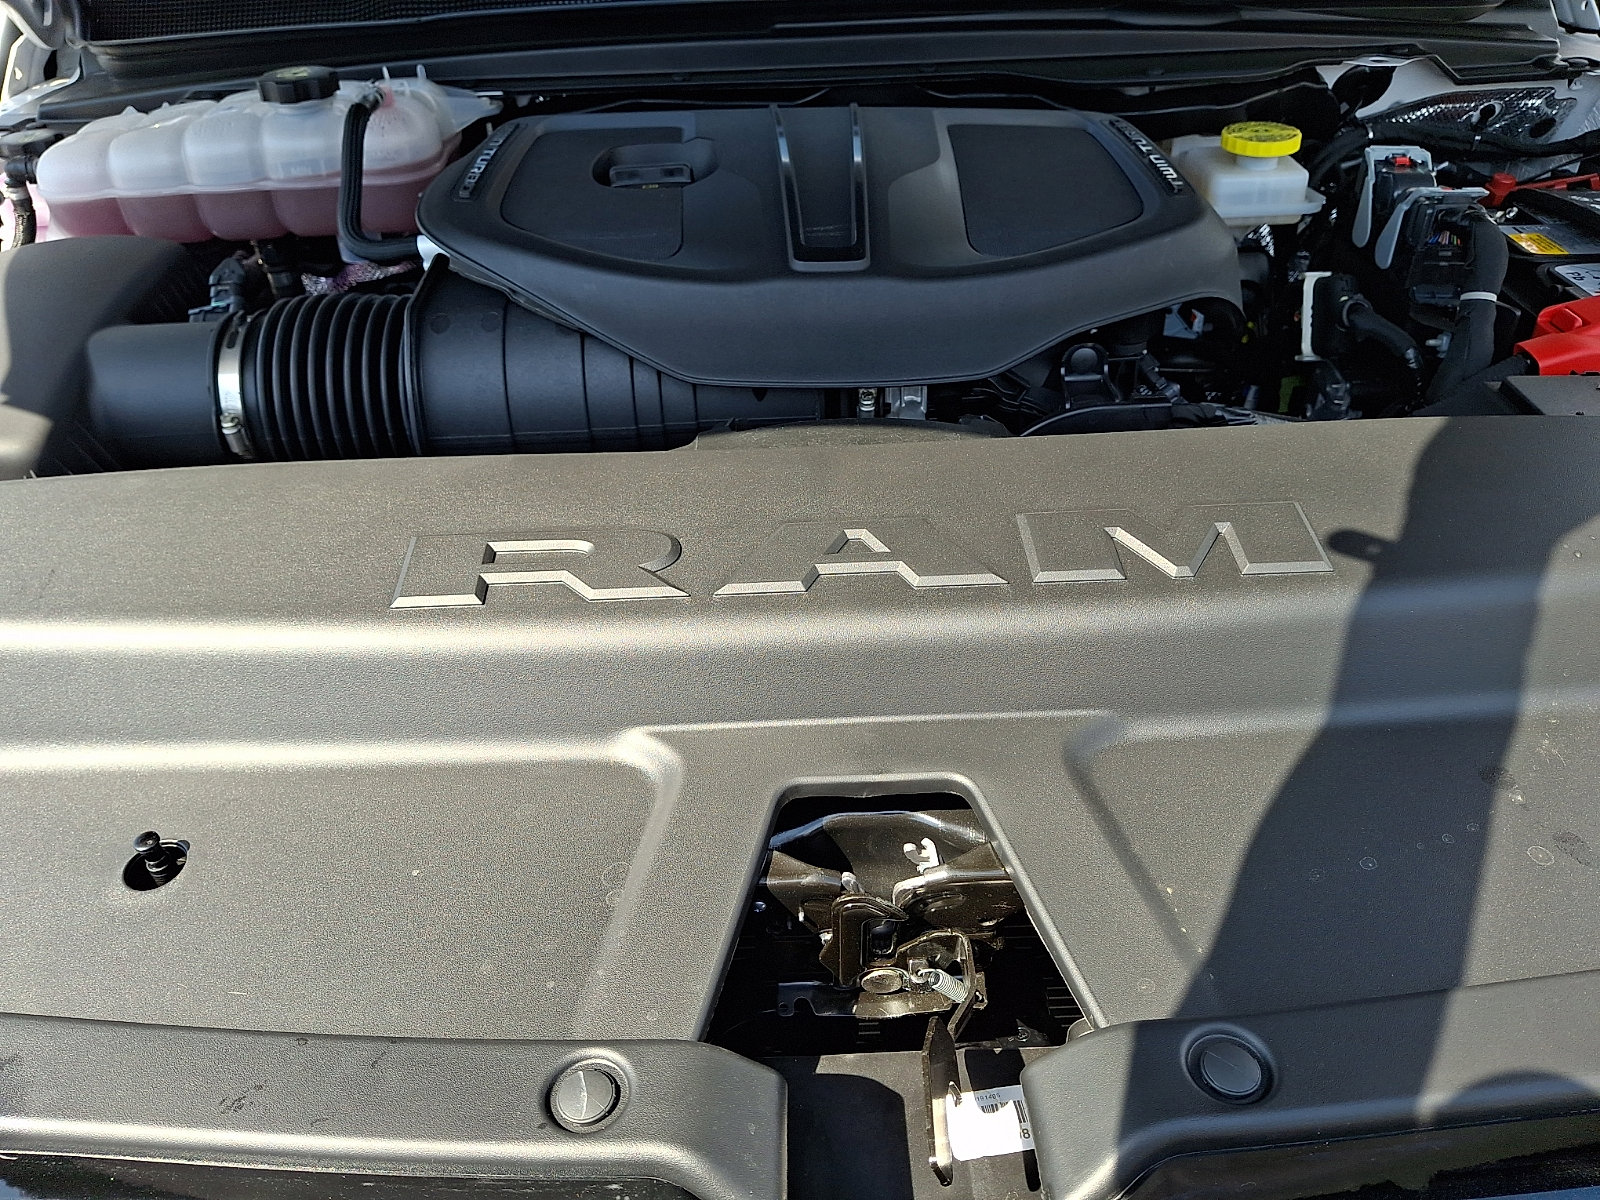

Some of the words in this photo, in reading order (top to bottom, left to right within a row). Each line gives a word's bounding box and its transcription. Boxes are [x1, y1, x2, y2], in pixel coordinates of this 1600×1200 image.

[1148, 154, 1184, 193] TWIN
[390, 501, 1334, 609] RAM
[1020, 1128, 1031, 1139] 8
